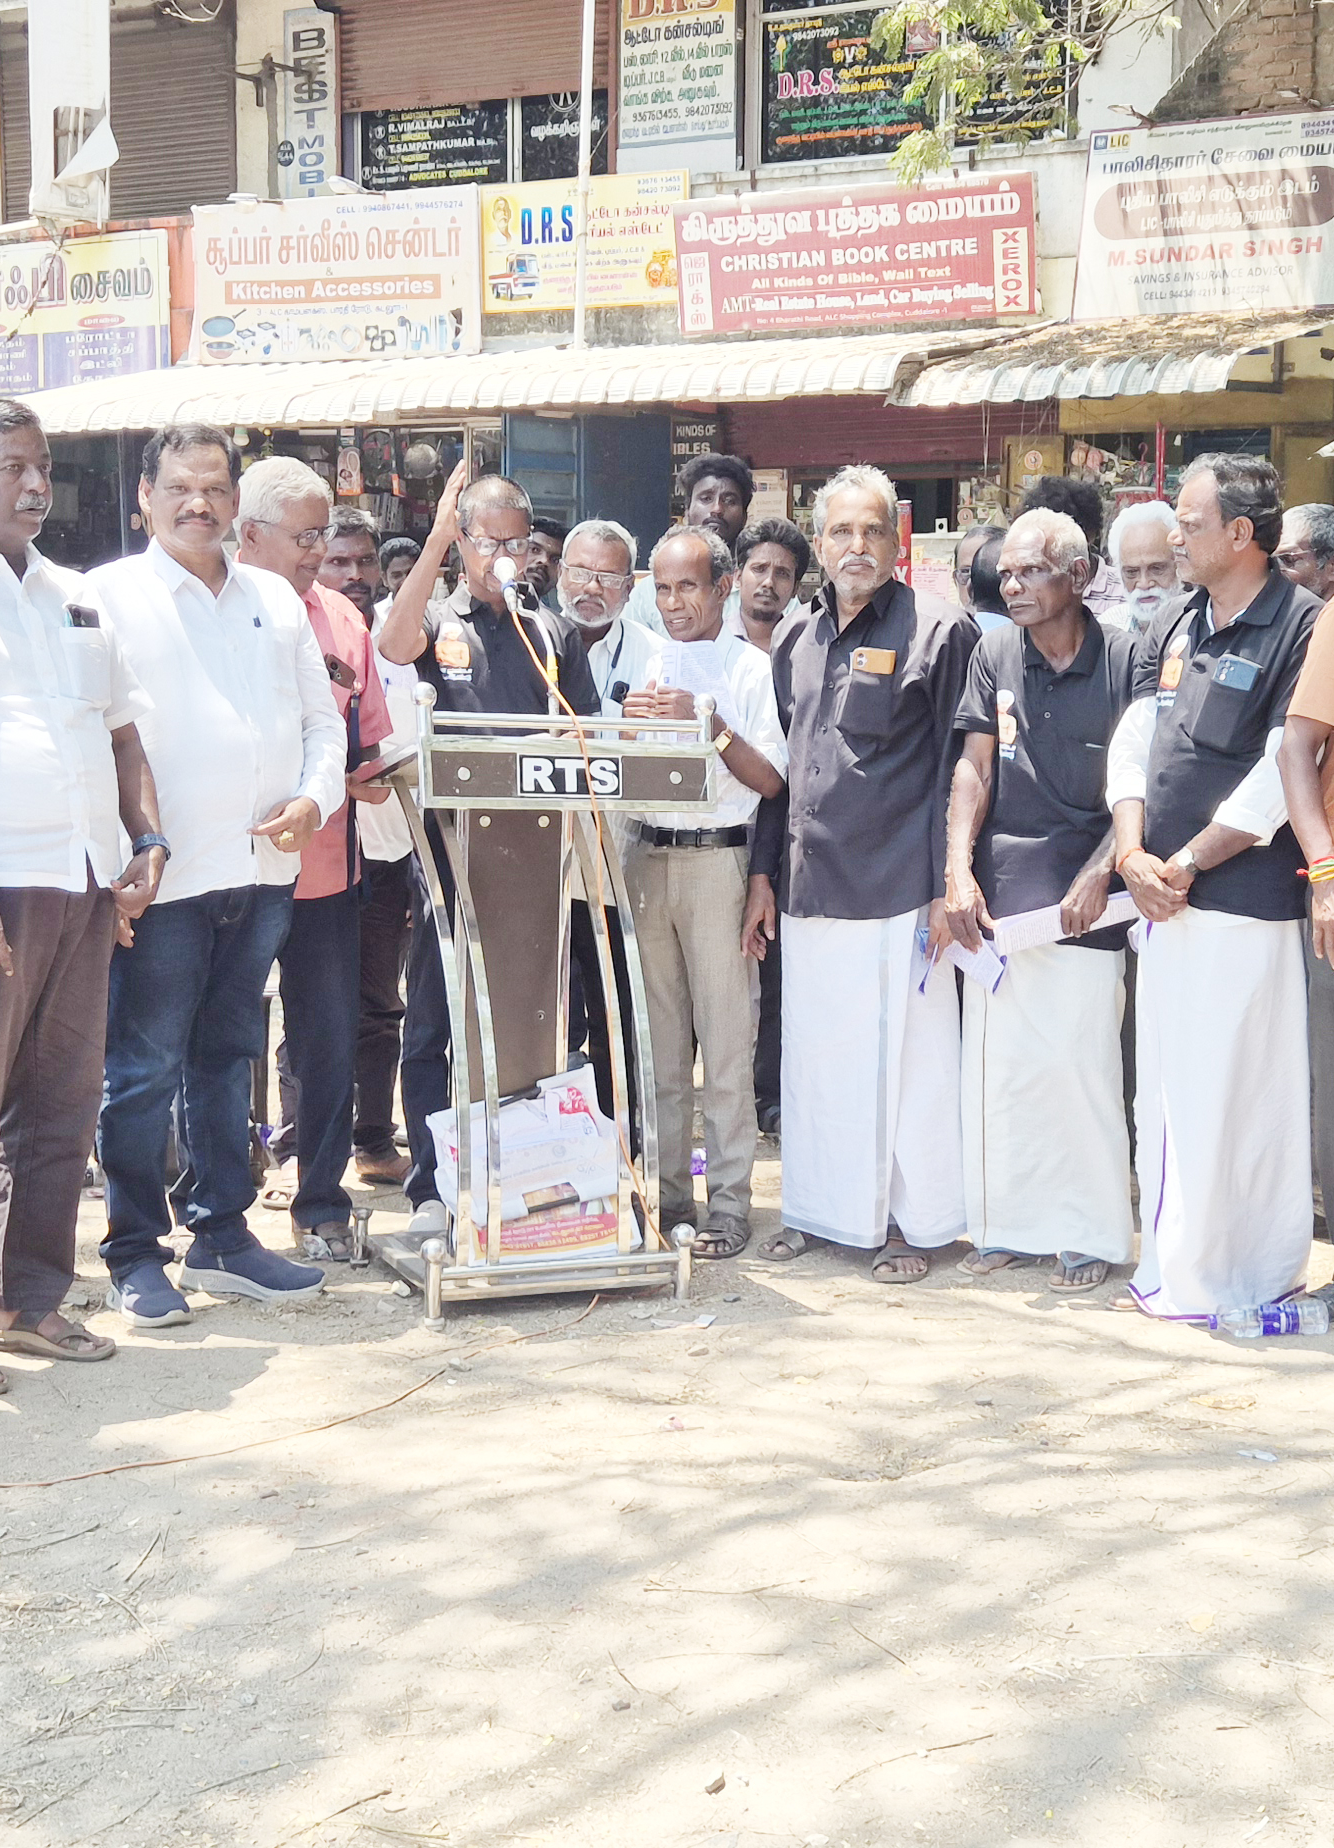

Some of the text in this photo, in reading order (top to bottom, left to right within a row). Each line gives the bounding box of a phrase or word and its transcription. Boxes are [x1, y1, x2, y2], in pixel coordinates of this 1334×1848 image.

[292, 27, 328, 129] BEST
[388, 137, 475, 154] T.SAMPATHKUMAR
[1110, 135, 1129, 148] LIC
[1103, 150, 1206, 175] பாலிசிதாரர்
[1211, 146, 1274, 166] சேவை
[336, 206, 356, 214] CELL
[415, 200, 463, 210] 9944576274
[1121, 175, 1319, 212] புதிய பாலிசி எடுக்கும் இடம்
[816, 195, 900, 239] புத்தக
[906, 180, 1020, 224] மையம்
[1141, 217, 1157, 231] LIC
[521, 204, 573, 245] D.R.S
[206, 216, 462, 275] சூப்பர் சர்வீஸ் சென்டர்
[721, 237, 978, 273] CHRISTIAN BOOK CENTRE
[1107, 236, 1323, 267] M.SUNDAR SINGH
[71, 257, 152, 303] சைவம்
[326, 267, 333, 276] &
[751, 266, 951, 289] All Kinds Of Bible, Wall Text
[1001, 230, 1022, 307] XEROX
[1128, 265, 1294, 285] SAVINGS & INSURANCE ADVISOR
[232, 277, 434, 300] Kitchen Accessories
[781, 295, 814, 311] Estate
[816, 293, 854, 309] House,
[856, 291, 889, 307] Land,
[890, 289, 910, 304] Car
[912, 286, 953, 305] Buying
[953, 282, 994, 300] Selling
[825, 313, 838, 321] ALC
[840, 311, 871, 321] Shopping
[676, 424, 717, 437] KINDS OF
[673, 442, 710, 456] IBLES
[521, 757, 619, 795] RTS
